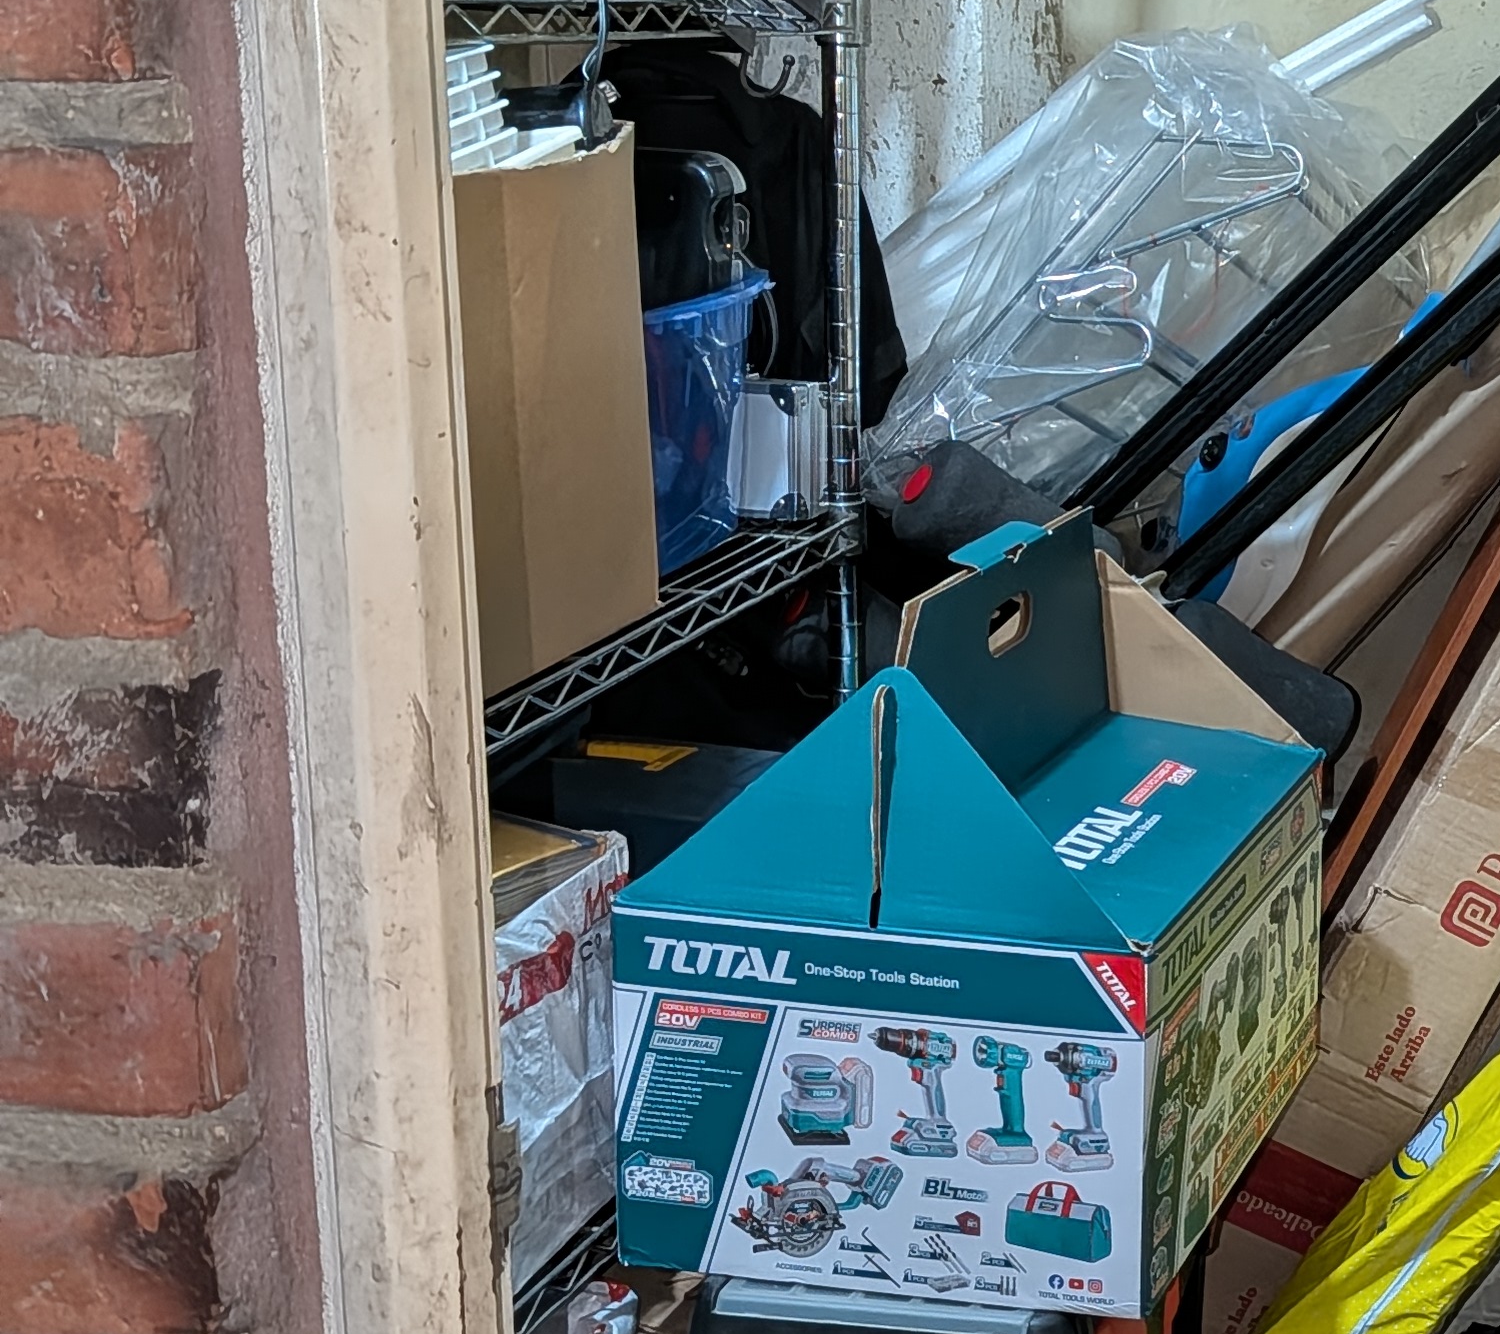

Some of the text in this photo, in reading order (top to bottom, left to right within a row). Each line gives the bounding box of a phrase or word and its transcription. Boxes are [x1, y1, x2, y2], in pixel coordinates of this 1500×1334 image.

[643, 935, 798, 985] TOTAL
[804, 962, 960, 990] One-Stop Tools Station
[1096, 961, 1137, 1012] TOTAL
[657, 1012, 699, 1026] 20V
[799, 1019, 860, 1037] SURPRISE
[655, 1035, 716, 1050] INDUSTRIAL
[813, 1029, 857, 1042] COMBO
[1364, 1006, 1416, 1083] Este lado
[1390, 1026, 1432, 1083] Arriba
[923, 1178, 953, 1198] BL
[1038, 1290, 1116, 1306] TOTAL TOOLS WORLD
[1227, 1287, 1258, 1325] lado
